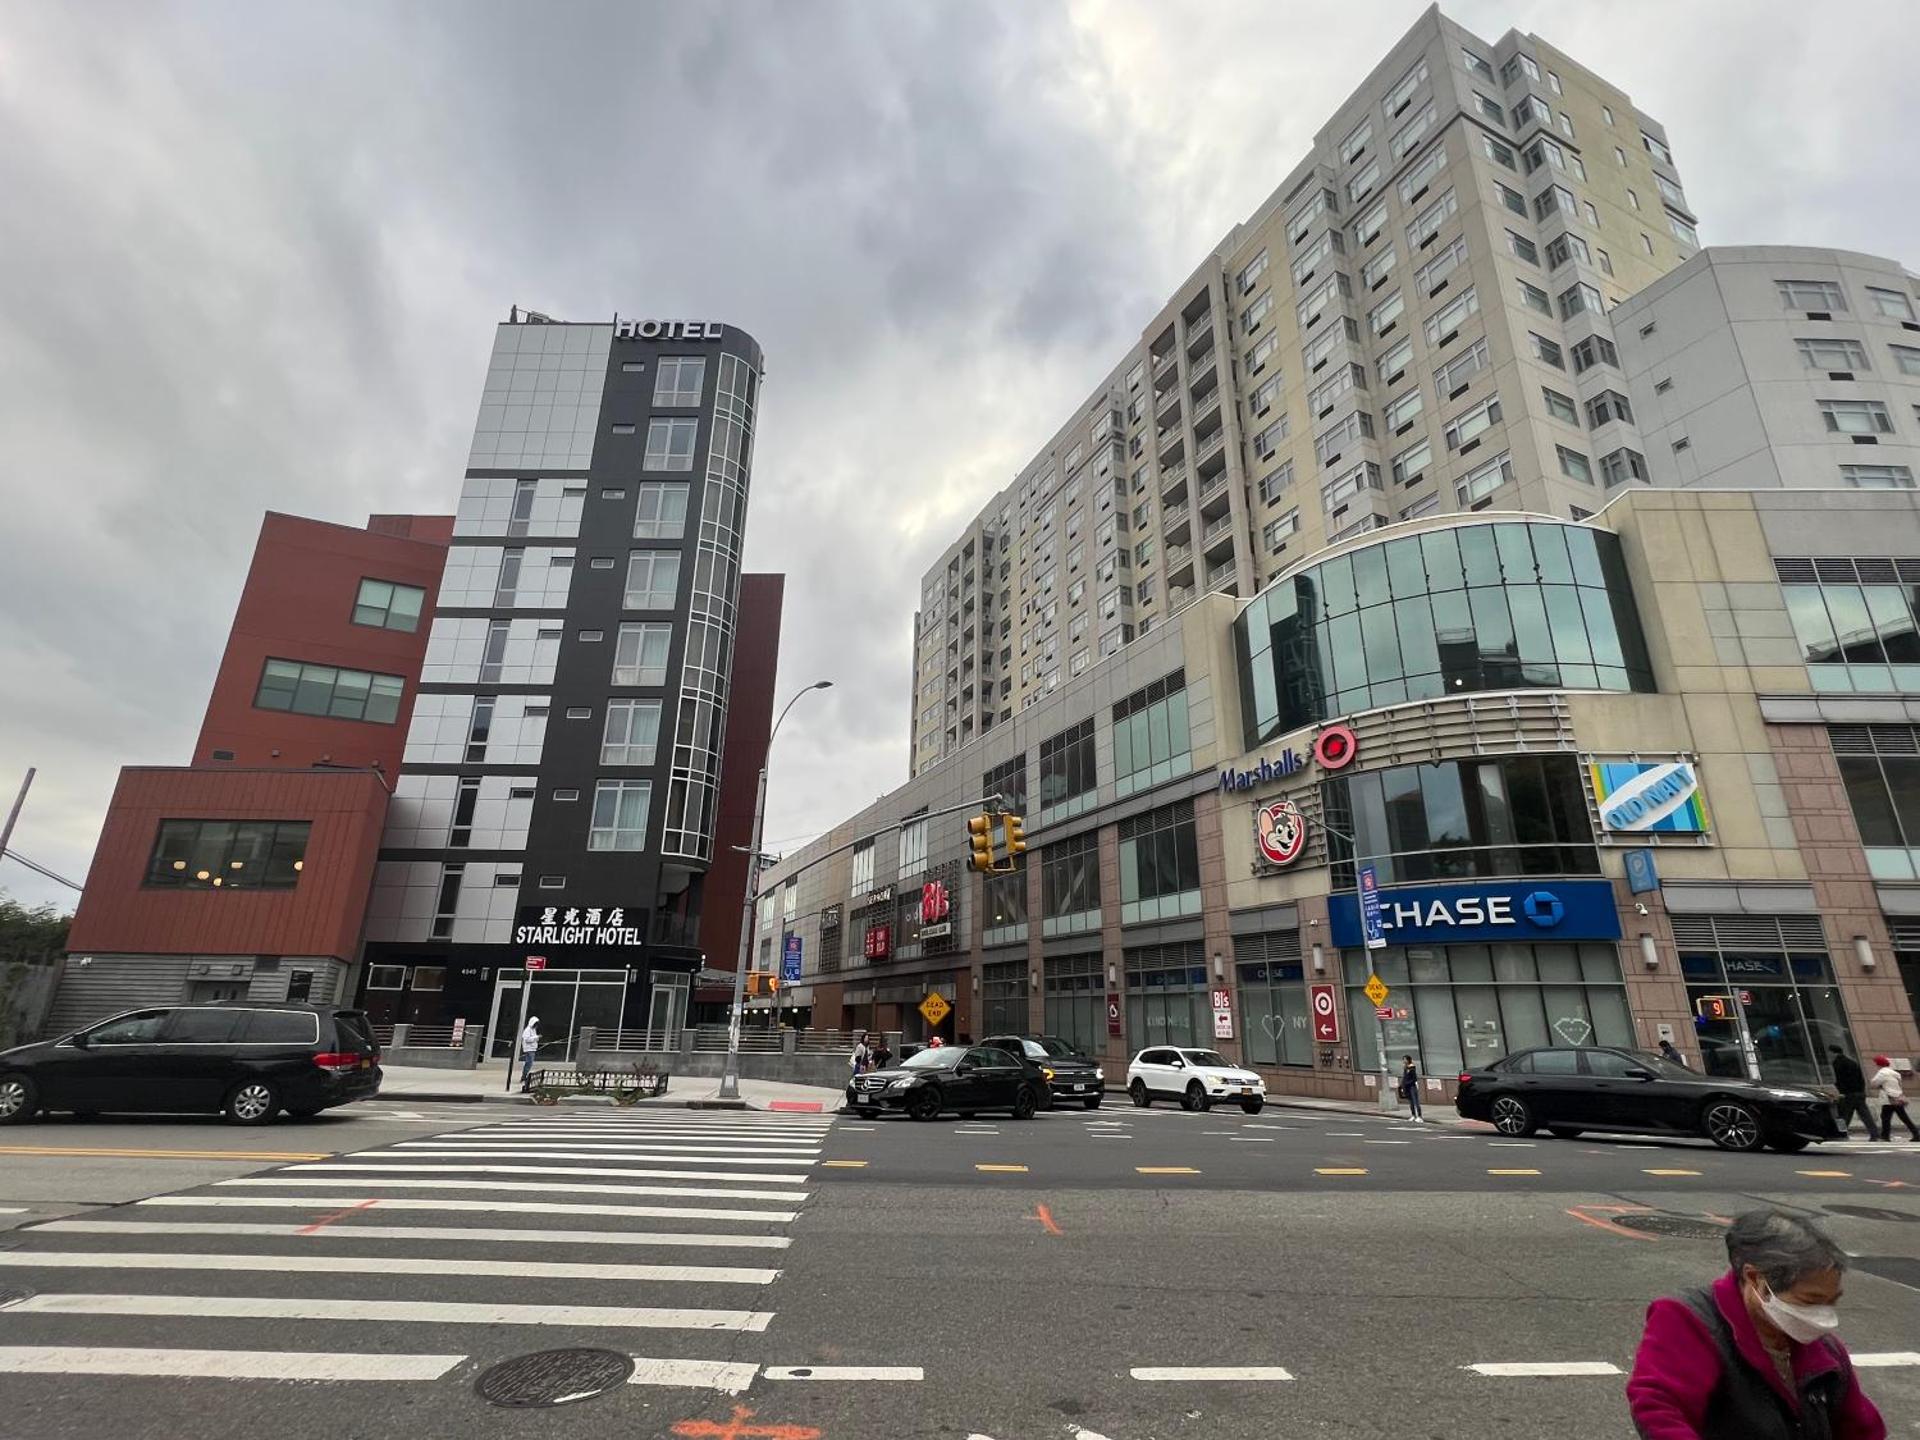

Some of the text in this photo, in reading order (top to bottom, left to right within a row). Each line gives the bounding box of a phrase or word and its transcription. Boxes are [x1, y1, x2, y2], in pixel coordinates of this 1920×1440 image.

[615, 319, 723, 339] HOTEL
[1218, 747, 1303, 793] Marshalls
[1605, 764, 1694, 829] OLD NAVY
[540, 907, 624, 926] 星光酒店
[517, 926, 641, 945] STARLIGHT HOTEL
[1726, 961, 1764, 972] HASE
[1213, 991, 1230, 1009] BJ's
[1712, 1001, 1721, 1015] 9
[1292, 1015, 1307, 1028] NY
